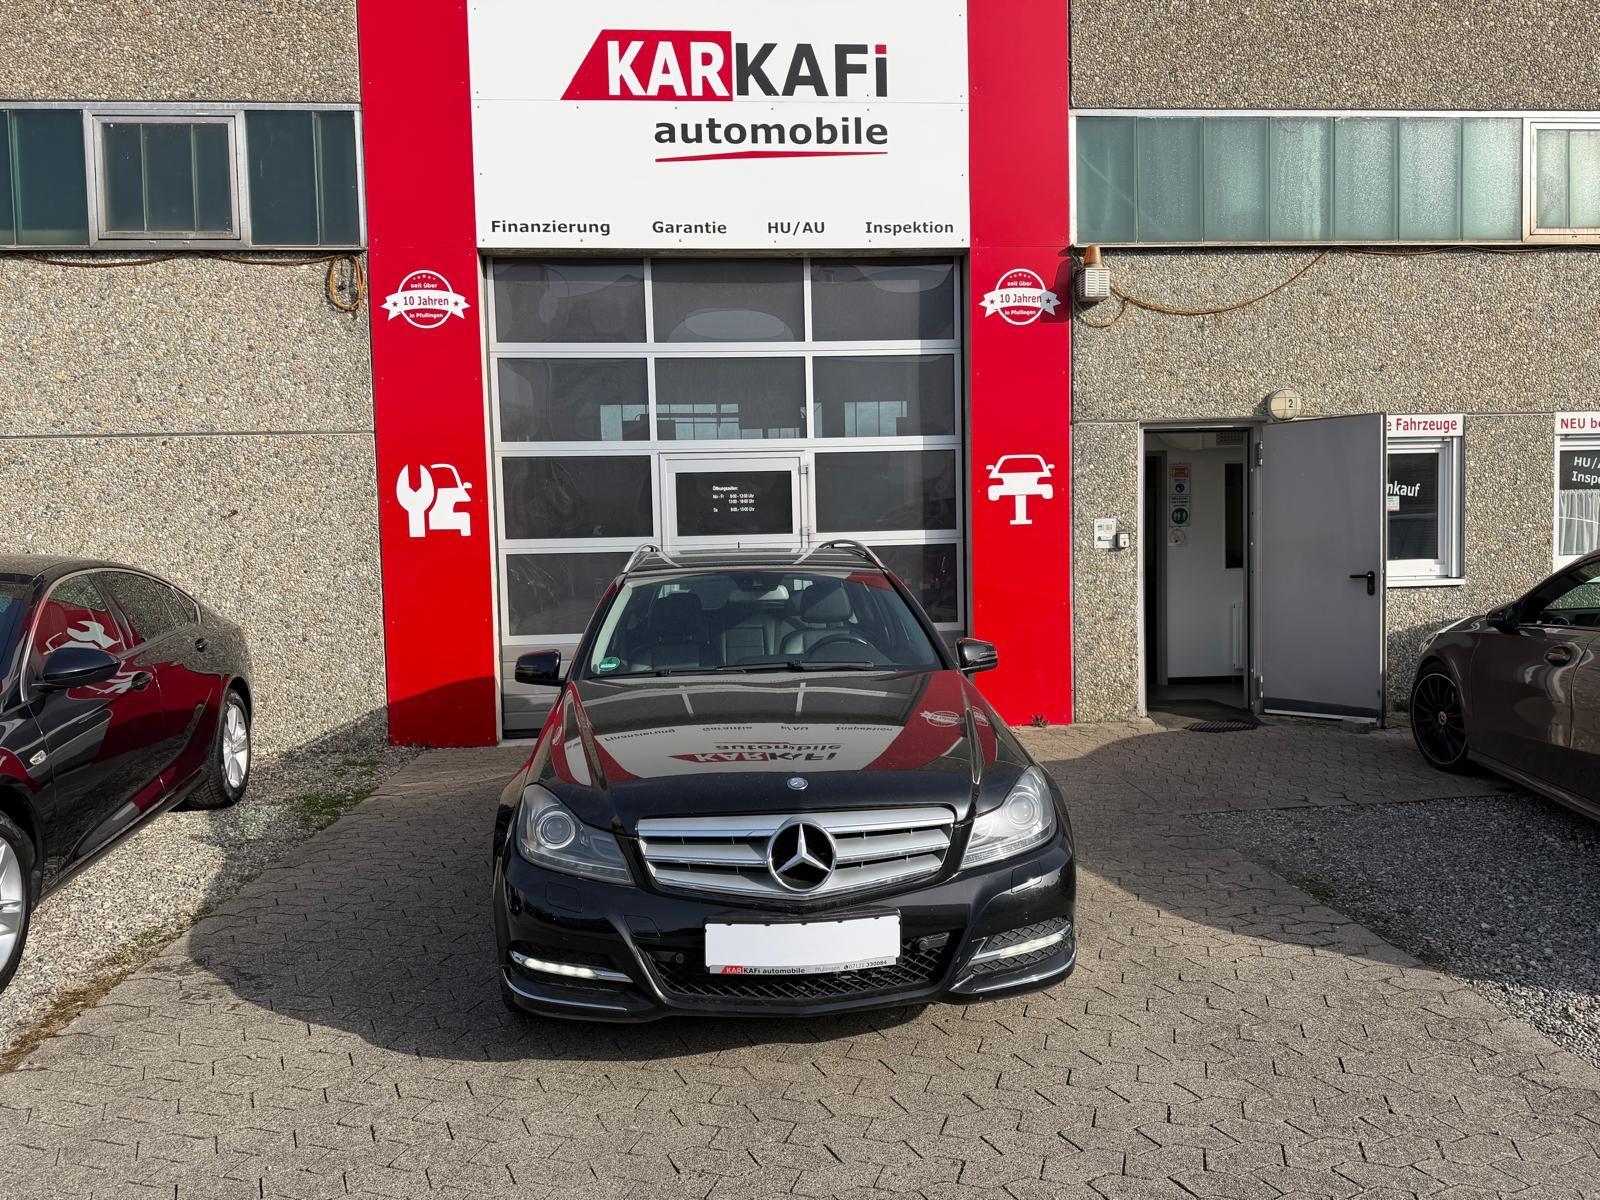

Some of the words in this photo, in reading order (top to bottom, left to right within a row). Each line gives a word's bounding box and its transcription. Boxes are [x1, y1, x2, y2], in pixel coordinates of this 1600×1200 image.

[606, 40, 889, 97] KARKAFi
[654, 116, 889, 145] automobile
[490, 220, 611, 237] Finanzierung
[651, 220, 728, 235] Garantie
[767, 221, 826, 235] HU/AU
[864, 220, 955, 237] Inspektion
[403, 296, 415, 306] 10
[417, 296, 449, 306] Jahren
[1000, 294, 1010, 304] 10
[1012, 294, 1042, 304] Jahren
[1288, 399, 1294, 408] 2
[1396, 418, 1458, 434] Fahrzeuge
[1560, 418, 1586, 430] NEU
[1387, 480, 1420, 496] nkauf
